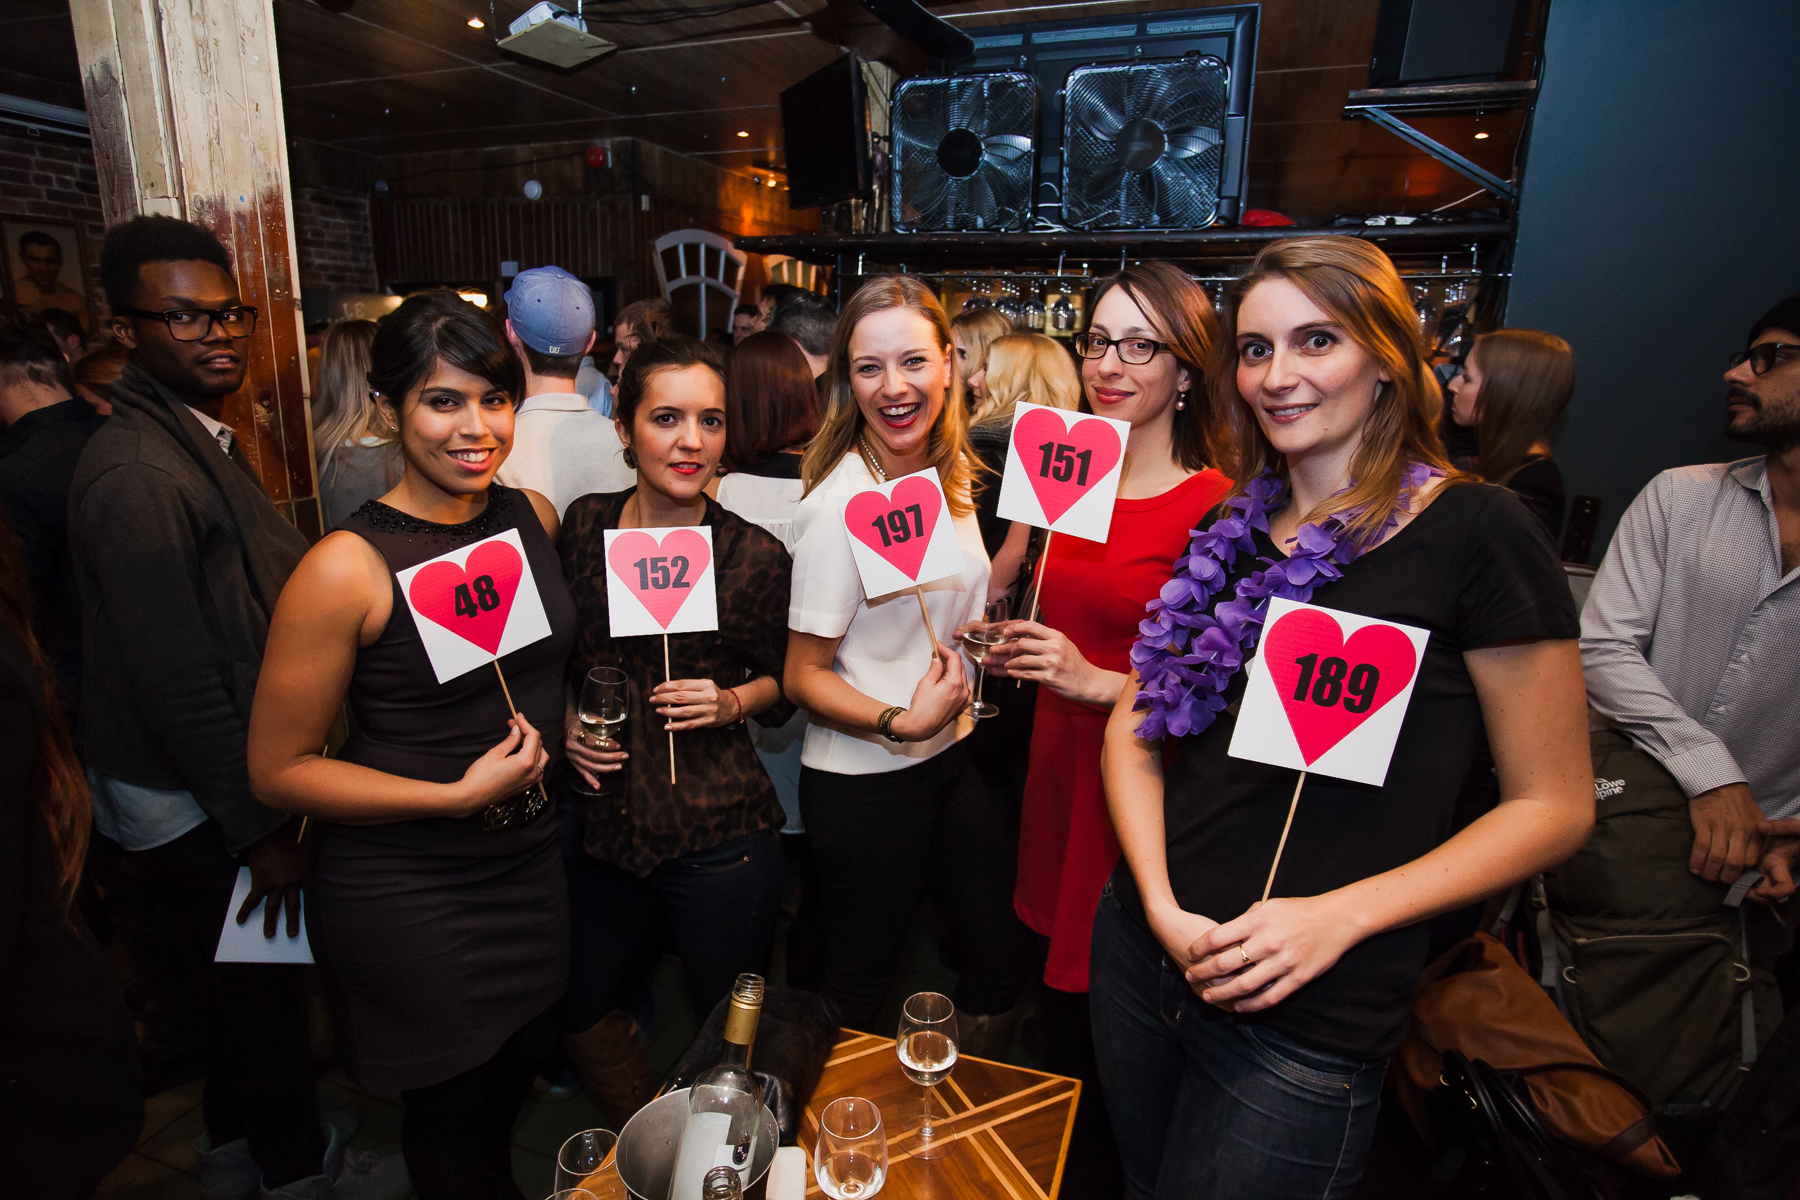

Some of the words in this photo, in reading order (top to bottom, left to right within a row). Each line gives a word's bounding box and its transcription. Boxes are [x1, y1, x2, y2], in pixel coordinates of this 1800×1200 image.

[1038, 441, 1092, 487] 151
[870, 503, 924, 548] 197
[633, 555, 690, 590] 152
[454, 574, 501, 619] 48
[1293, 652, 1380, 714] 189
[1594, 779, 1626, 791] Lowe
[1595, 786, 1624, 801] lpine
